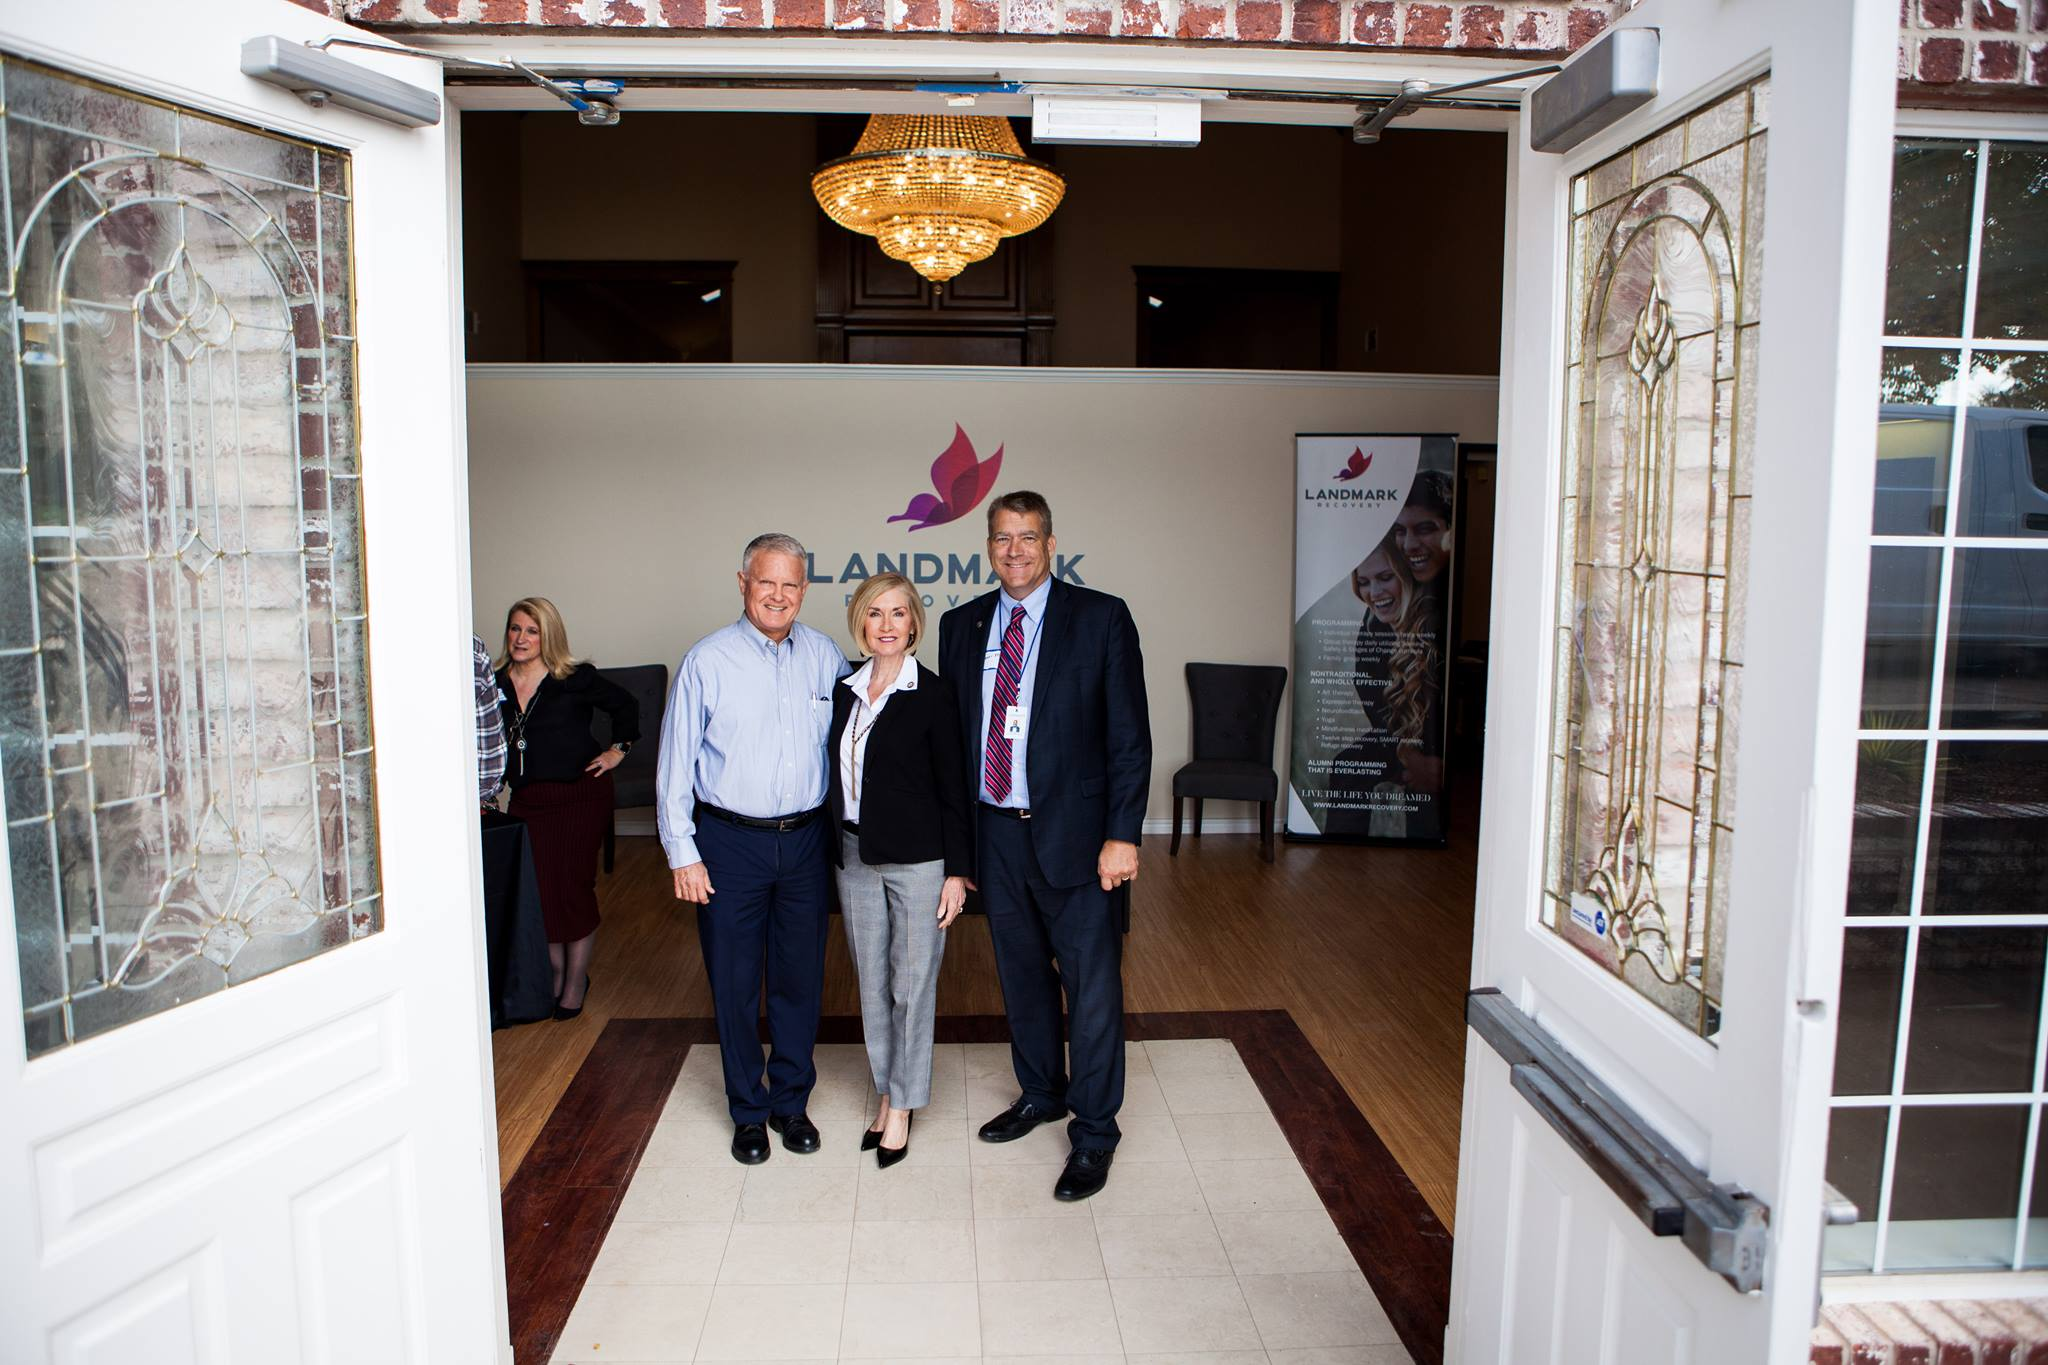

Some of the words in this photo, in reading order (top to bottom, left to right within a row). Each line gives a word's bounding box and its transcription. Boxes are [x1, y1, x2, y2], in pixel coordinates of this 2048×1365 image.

[1305, 489, 1398, 501] LANDMARK
[808, 553, 1086, 585] LANDMK
[1302, 789, 1323, 798] LIVE
[1325, 790, 1342, 799] THE
[1344, 791, 1363, 799] LIFE
[1365, 791, 1384, 800] YOU
[1386, 792, 1432, 802] DREAMED
[1313, 802, 1419, 812] WWW.LANDMARKRECOVERY.COM
